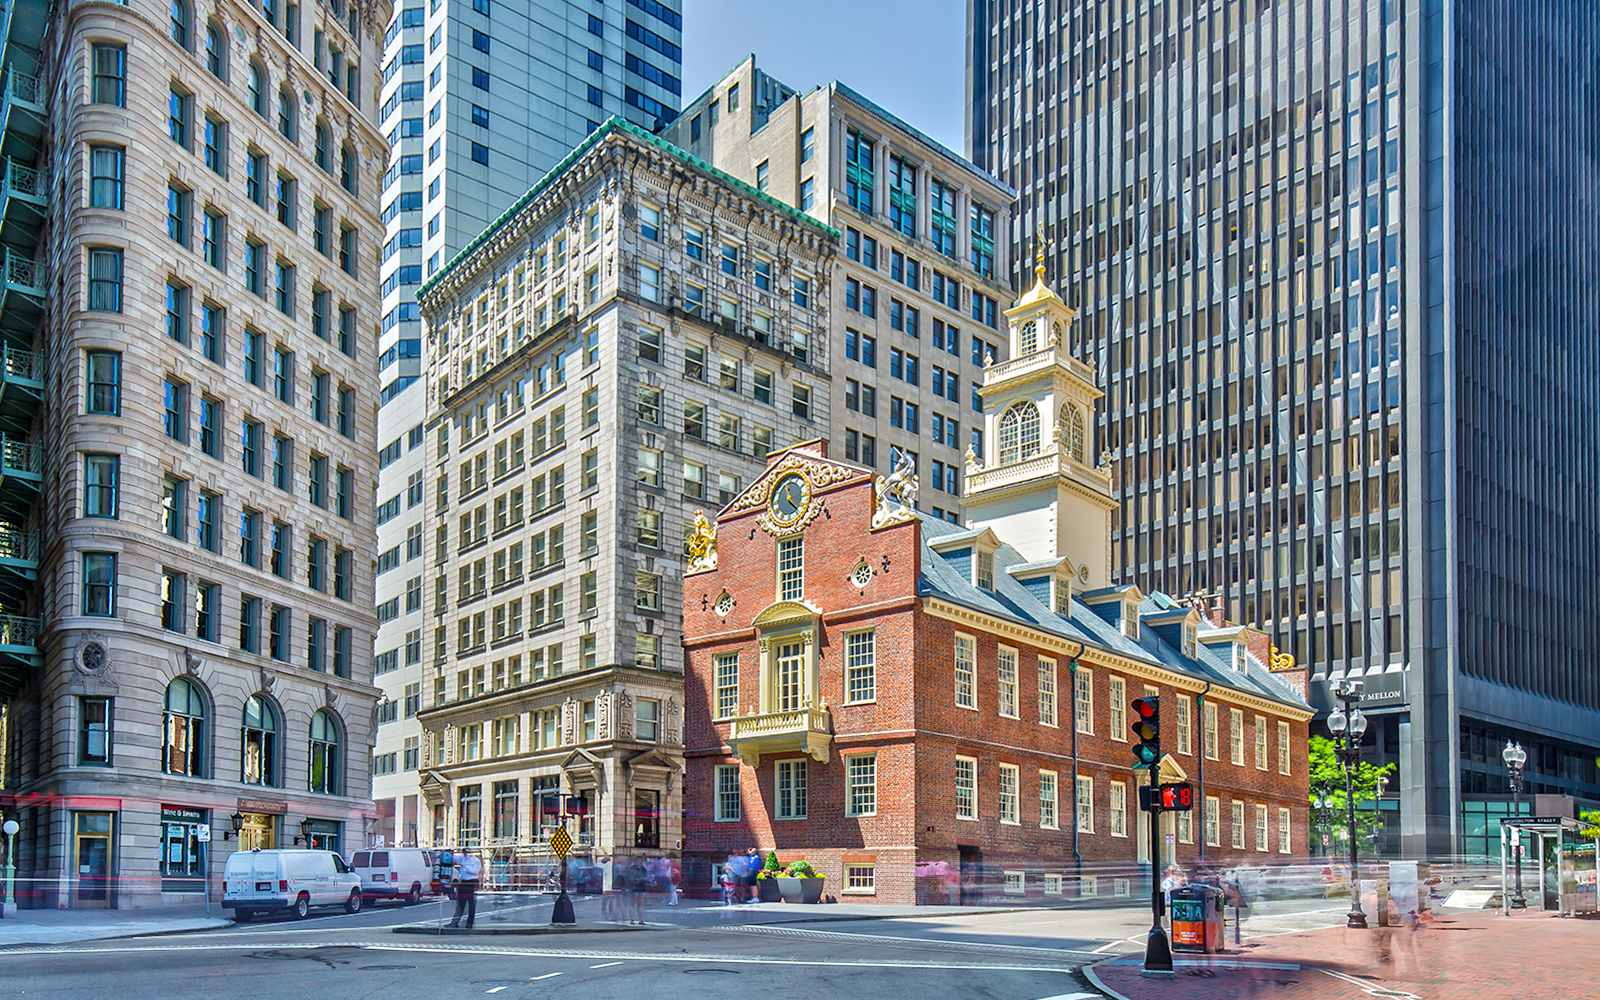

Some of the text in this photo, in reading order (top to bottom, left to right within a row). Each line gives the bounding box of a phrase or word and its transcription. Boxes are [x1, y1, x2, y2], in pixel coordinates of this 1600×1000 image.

[1367, 690, 1401, 701] MELLON
[1180, 788, 1191, 805] 18
[182, 810, 200, 818] SPIRITS
